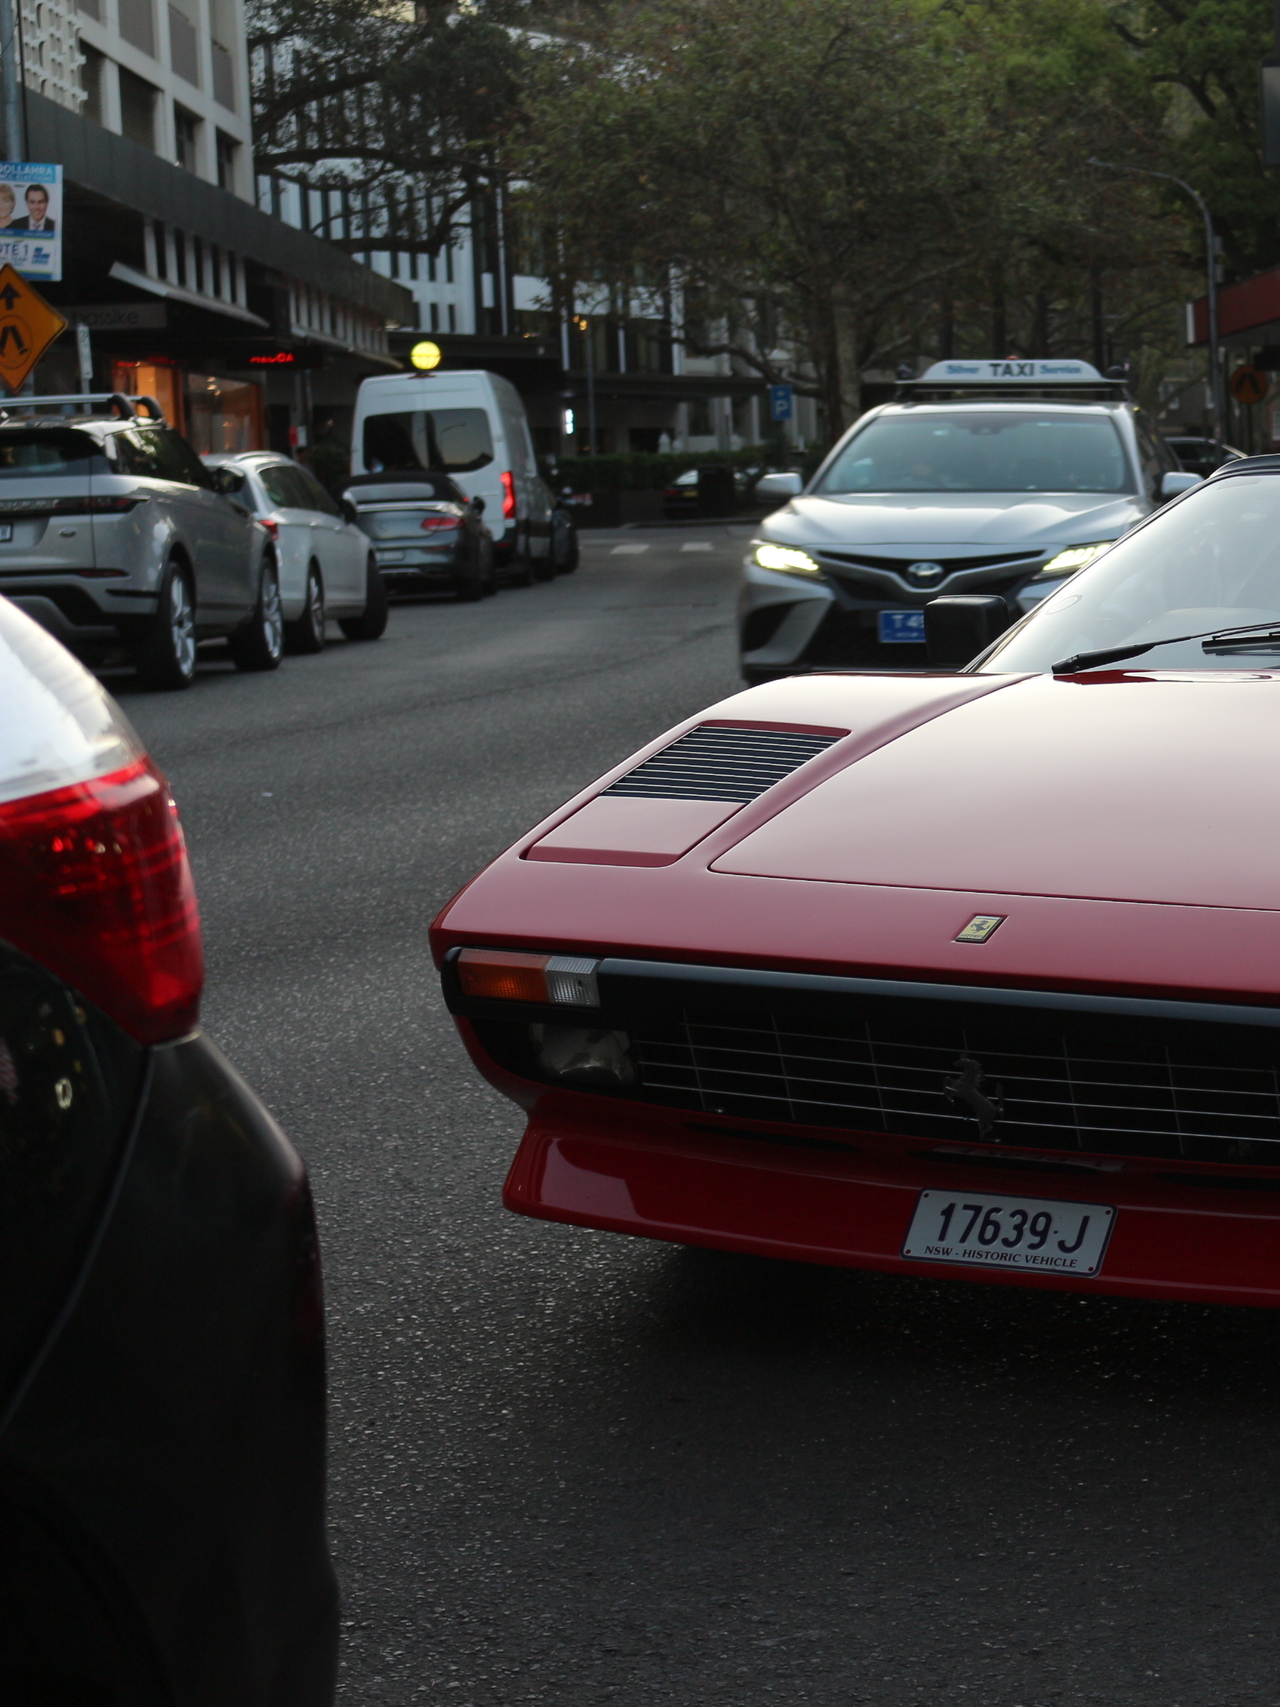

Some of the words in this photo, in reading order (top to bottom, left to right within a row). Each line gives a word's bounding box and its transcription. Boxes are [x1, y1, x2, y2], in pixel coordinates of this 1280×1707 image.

[23, 244, 29, 256] 1
[989, 363, 1035, 377] TAXI
[924, 1245, 953, 1257] NSW
[962, 1249, 1022, 1263] HISTORIC
[1025, 1254, 1078, 1268] VEHICLE
